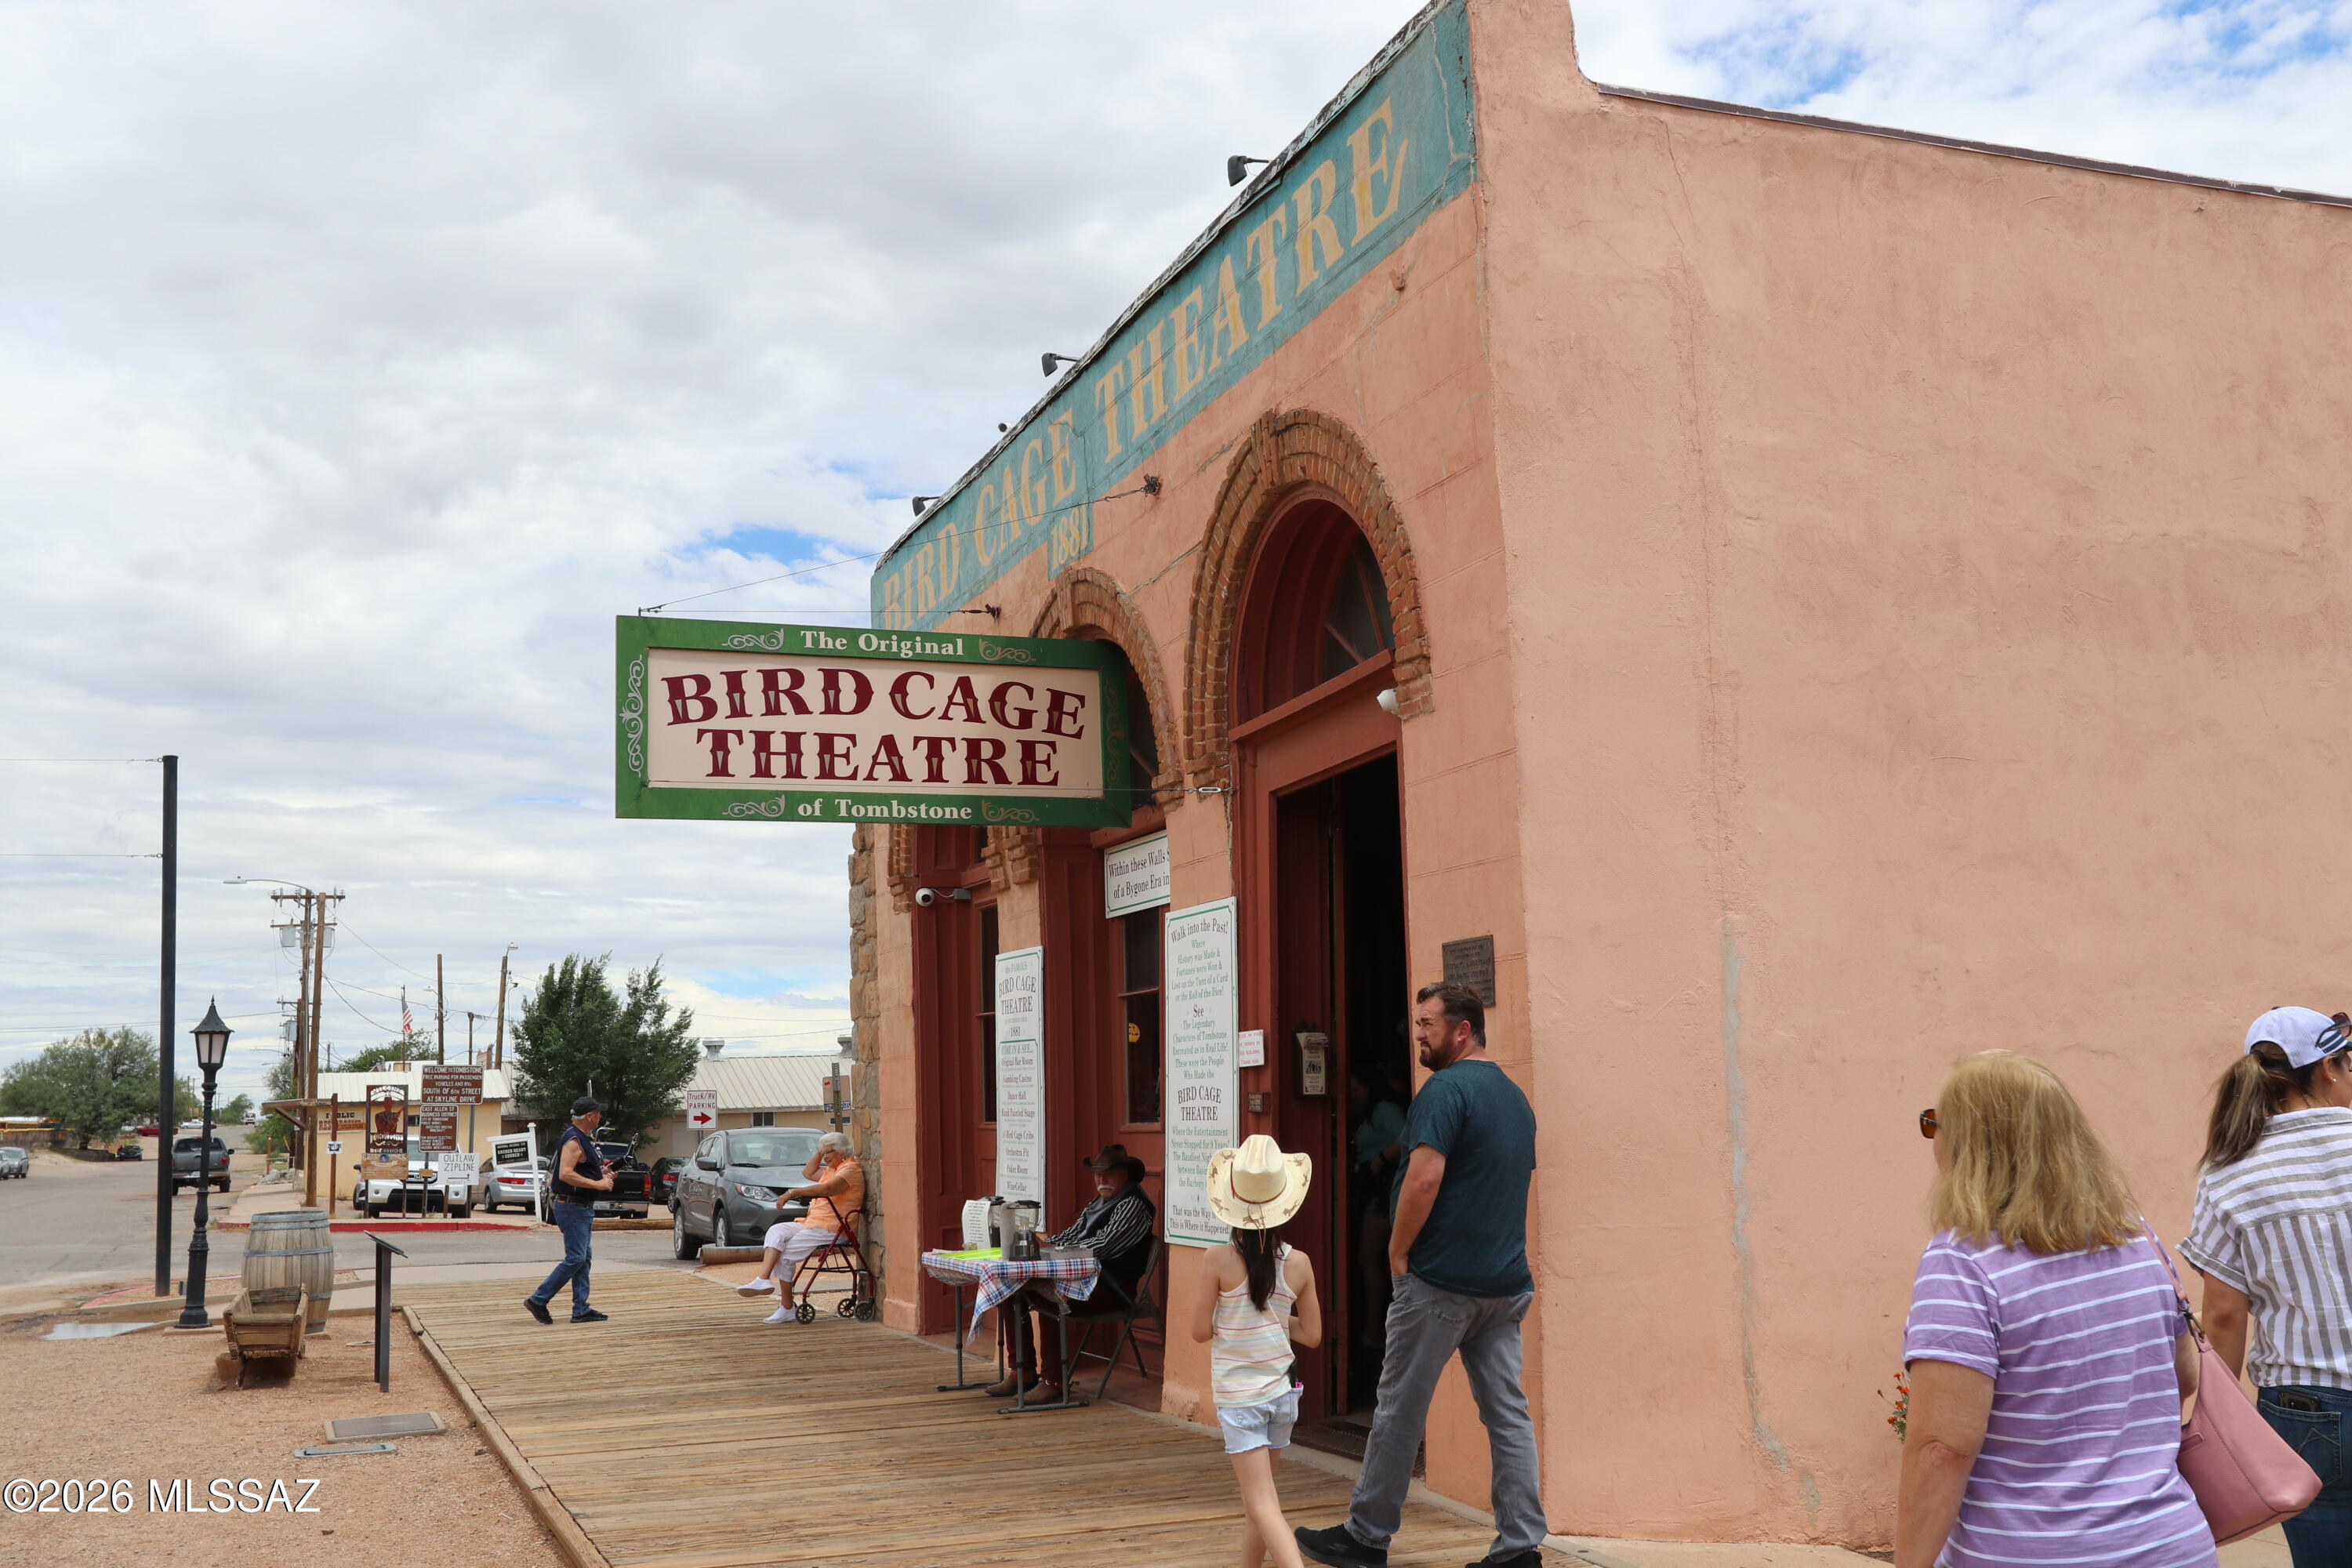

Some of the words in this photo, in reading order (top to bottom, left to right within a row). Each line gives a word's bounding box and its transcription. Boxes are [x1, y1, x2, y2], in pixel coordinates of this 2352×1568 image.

[881, 524, 960, 630] BIRD
[975, 409, 1076, 568] CAGE
[1095, 97, 1408, 463] THEATRE
[1050, 506, 1089, 571] 1881
[800, 630, 846, 651] The
[858, 633, 964, 657] Original
[661, 668, 873, 725] BIRD
[888, 670, 1085, 739] CAGE
[696, 729, 1059, 786] THEATRE
[798, 798, 822, 817] of
[835, 799, 971, 820] Tombstone
[1109, 862, 1129, 878] Within
[1131, 857, 1146, 872] these
[1149, 849, 1165, 866] Walls
[1114, 884, 1120, 898] of
[1127, 882, 1149, 898] Bygone
[1151, 875, 1161, 889] Era
[1171, 925, 1186, 944] Walk
[1188, 923, 1199, 935] into
[1201, 918, 1210, 931] the
[1212, 918, 1228, 934] Past!
[1192, 940, 1205, 949] Where
[1178, 955, 1193, 964] History
[1204, 949, 1215, 959] Made
[1217, 948, 1220, 957] &
[1177, 967, 1195, 977] Fortunes
[1207, 962, 1217, 971] Won
[1218, 961, 1222, 970] &
[999, 977, 1014, 997] BIRD
[1016, 975, 1036, 993] CAGE
[1172, 980, 1181, 989] Lost
[1196, 977, 1206, 986] Turn
[1207, 975, 1212, 985] of
[1217, 972, 1228, 983] Card
[1199, 988, 1203, 998] of
[1212, 986, 1223, 996] Dice!
[1001, 996, 1033, 1014] THEATRE
[1193, 1004, 1204, 1018] See
[1011, 1026, 1021, 1036] 1881
[1192, 1018, 1215, 1030] Legendary
[1173, 1034, 1196, 1043] Characters
[1197, 1032, 1202, 1041] of
[1202, 1031, 1227, 1040] Tombstone
[1173, 1045, 1193, 1055] Recreated
[1206, 1043, 1216, 1053] Real
[1218, 1042, 1228, 1051] Life!
[1002, 1058, 1014, 1066] Original
[1022, 1057, 1033, 1065] Room
[1176, 1058, 1187, 1068] These
[1209, 1056, 1224, 1066] People
[1019, 1074, 1032, 1083] Casino
[1184, 1071, 1192, 1080] Who
[1194, 1070, 1206, 1079] Made
[1178, 1086, 1196, 1104] BIRD
[1200, 1086, 1221, 1103] CAGE
[1024, 1108, 1035, 1118] Stage
[1181, 1106, 1218, 1120] THEATRE
[1014, 1131, 1022, 1141] Cage
[1172, 1127, 1185, 1135] Where
[1194, 1127, 1228, 1136] Entertainment
[1006, 1147, 1022, 1156] Orchestra
[1171, 1139, 1183, 1148] Never
[1185, 1140, 1201, 1151] Stopped
[1007, 1164, 1016, 1173] Poker
[1018, 1165, 1028, 1174] Room
[1178, 1164, 1195, 1174] between
[1173, 1205, 1183, 1215] That
[1201, 1207, 1210, 1220] Way
[1170, 1218, 1179, 1229] This
[1180, 1220, 1184, 1229] is
[1185, 1220, 1198, 1231] Where
[1200, 1221, 1203, 1232] it
[1204, 1221, 1229, 1235] Happened!
